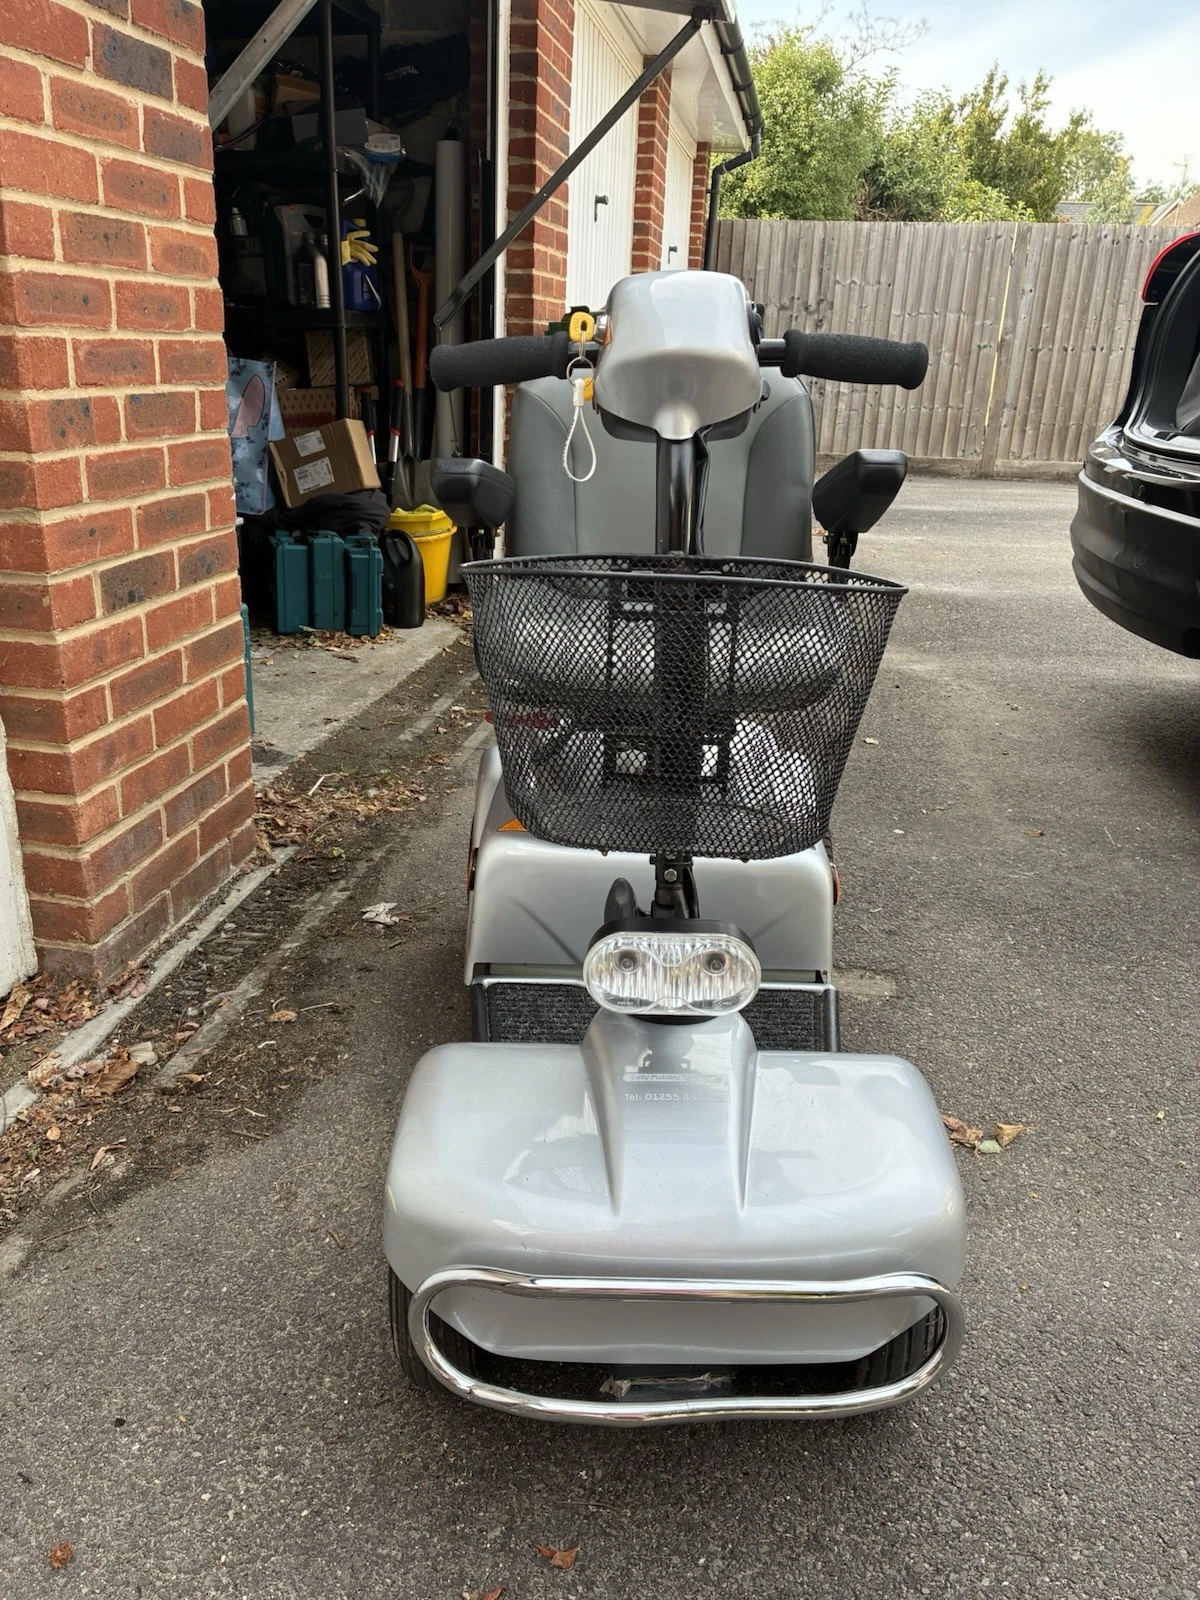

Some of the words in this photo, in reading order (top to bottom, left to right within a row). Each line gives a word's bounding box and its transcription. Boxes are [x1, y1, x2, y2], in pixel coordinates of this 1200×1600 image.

[651, 1074, 680, 1082] Mobility
[625, 1093, 642, 1101] Tel:
[645, 1093, 680, 1101] 01255
